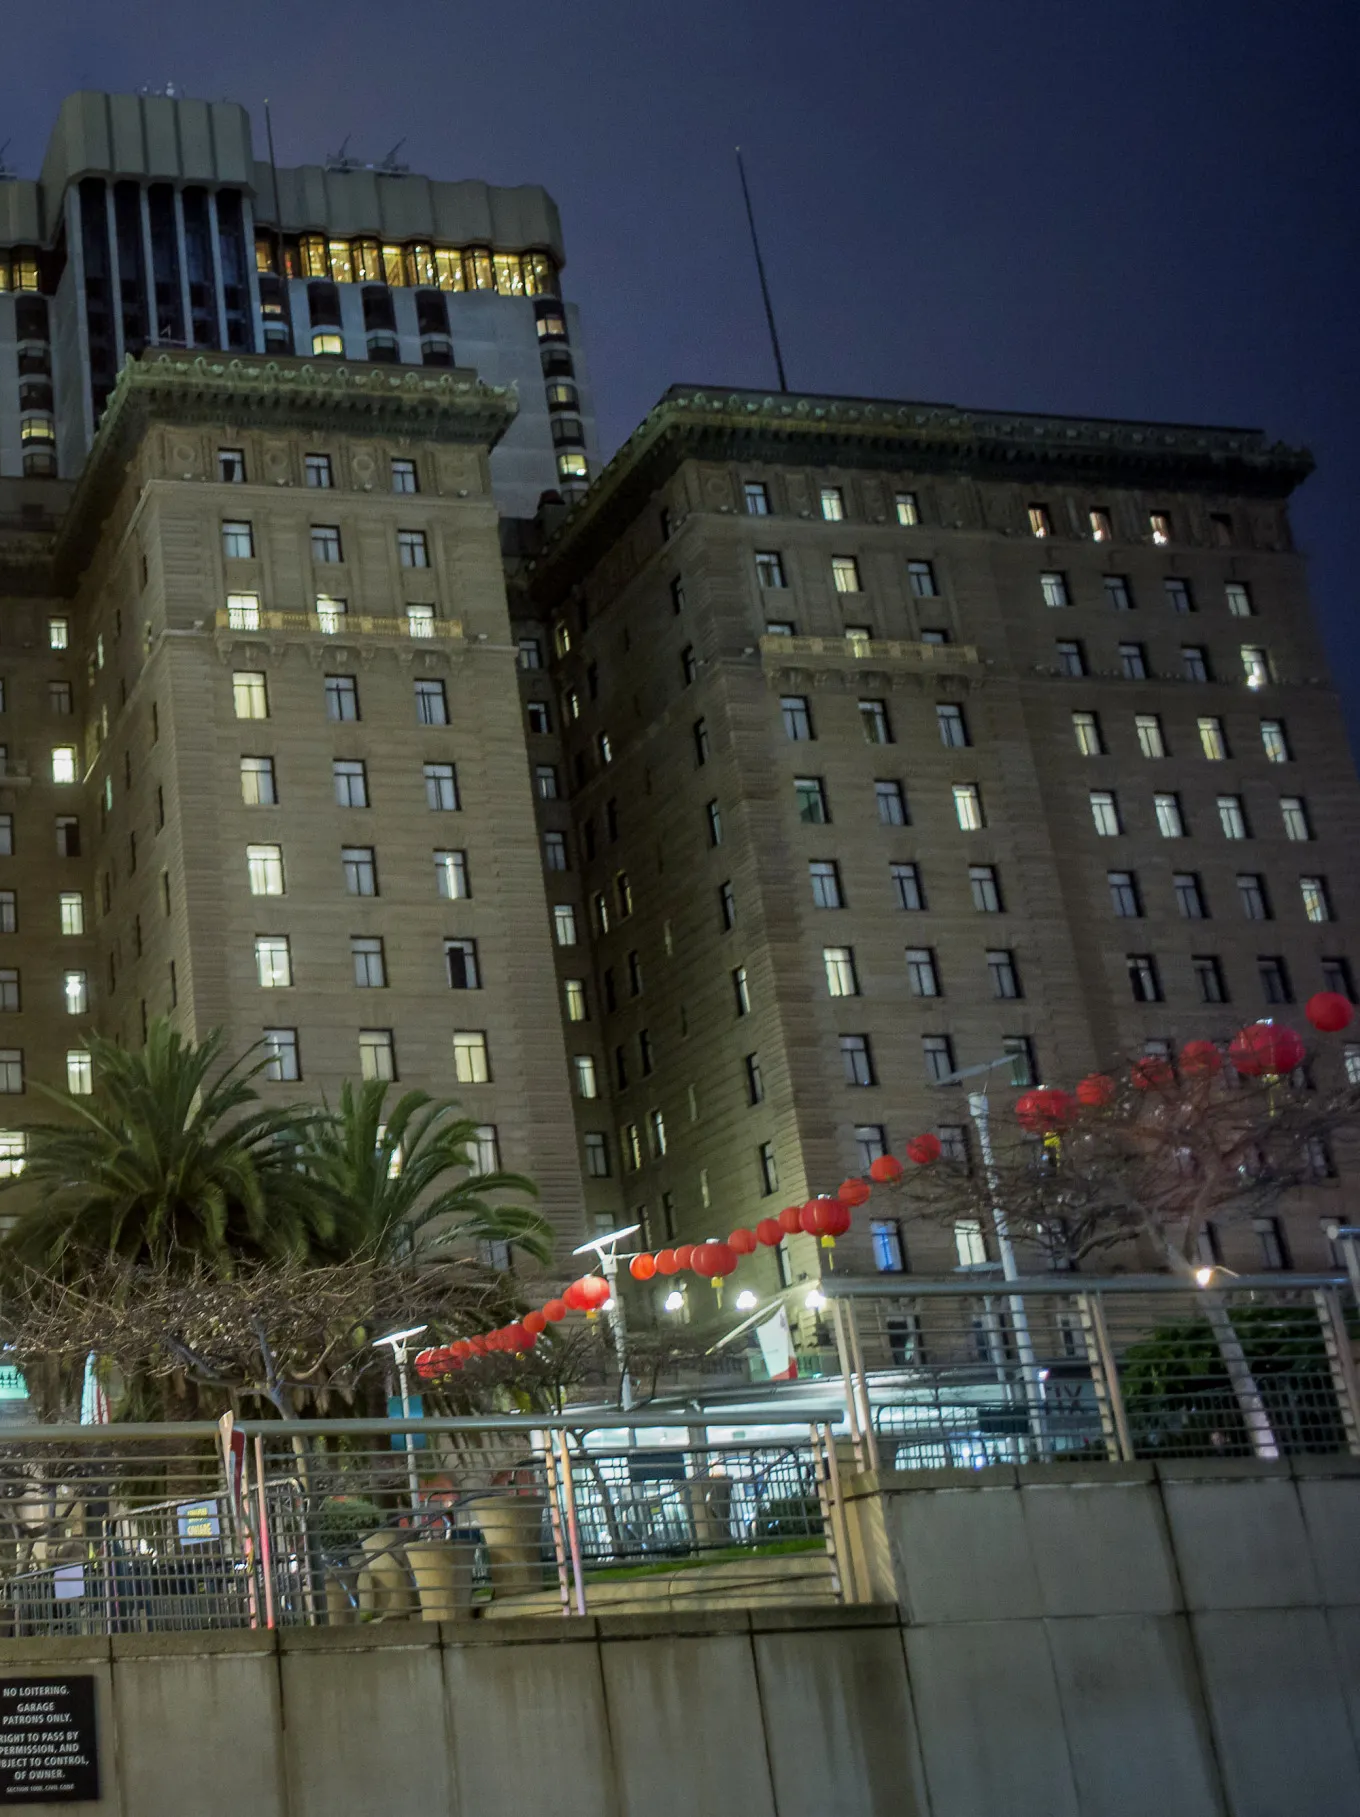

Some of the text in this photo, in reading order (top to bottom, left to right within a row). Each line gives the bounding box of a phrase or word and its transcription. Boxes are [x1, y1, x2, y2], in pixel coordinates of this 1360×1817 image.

[3, 1685, 70, 1697] NO LOITERING.
[17, 1702, 55, 1712] GARAGE
[2, 1713, 72, 1725] PATRONS ONLY.
[27, 1732, 40, 1742] TO
[41, 1732, 65, 1742] PASS
[66, 1731, 80, 1741] BY
[59, 1743, 80, 1753] AND
[29, 1757, 42, 1767] TO
[44, 1755, 90, 1767] CONTROL,
[14, 1769, 66, 1781] OF OWNER.
